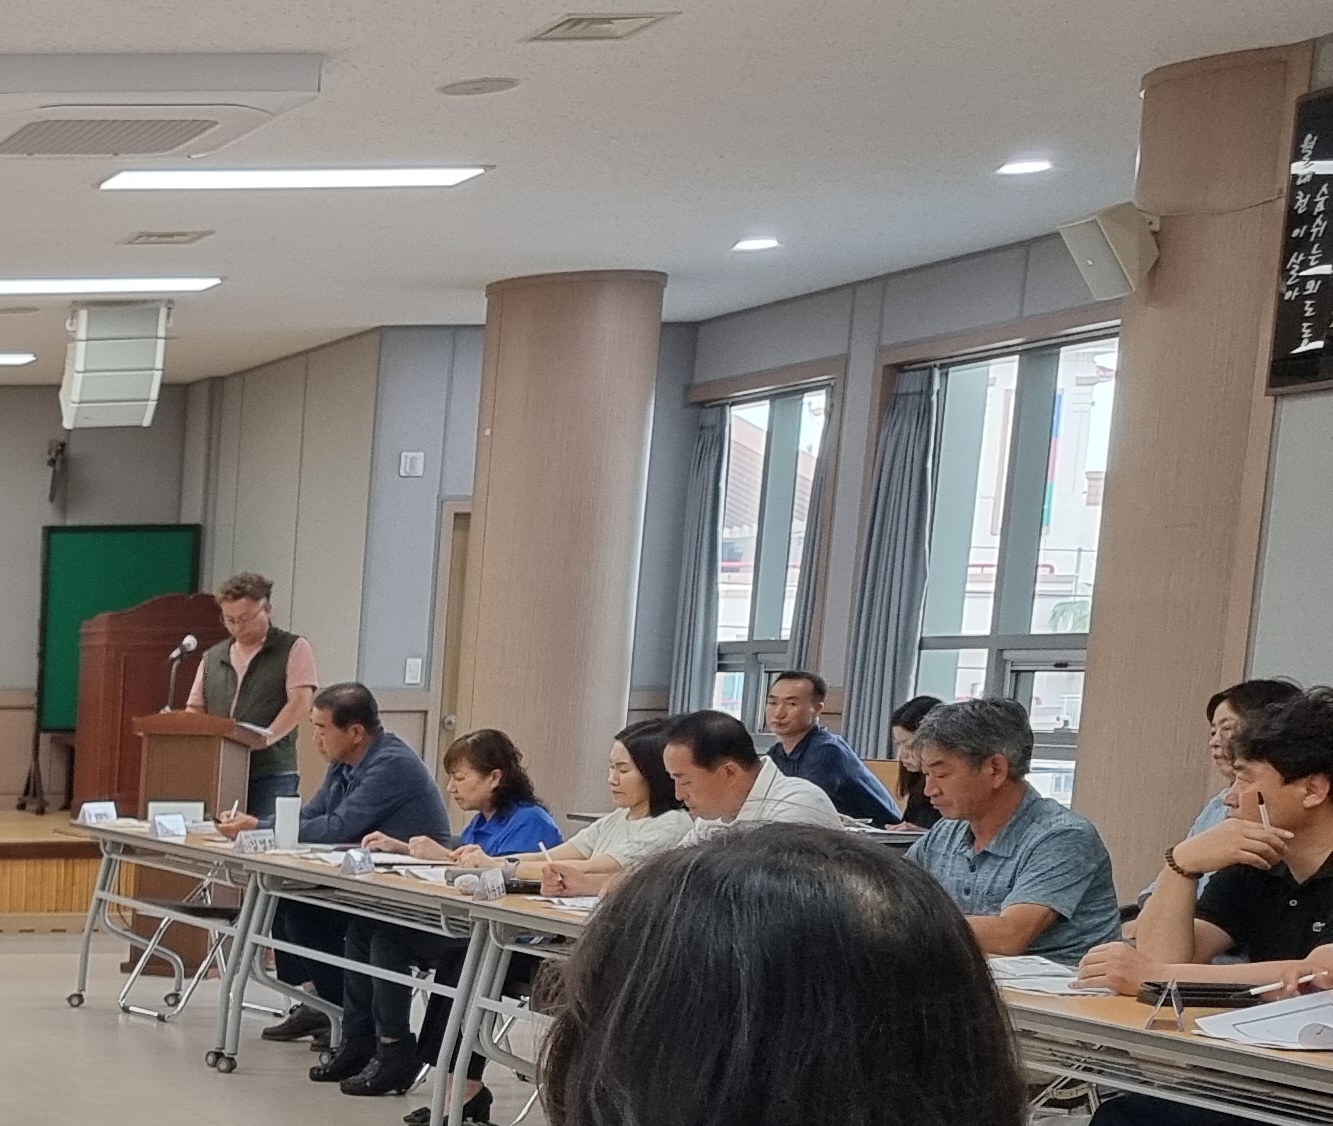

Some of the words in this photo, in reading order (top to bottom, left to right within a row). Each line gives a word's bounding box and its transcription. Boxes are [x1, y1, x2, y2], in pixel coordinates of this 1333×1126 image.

[1308, 182, 1329, 267] 숨쉬는
[1284, 251, 1304, 301] 살아
[1300, 279, 1321, 348] 외도동
